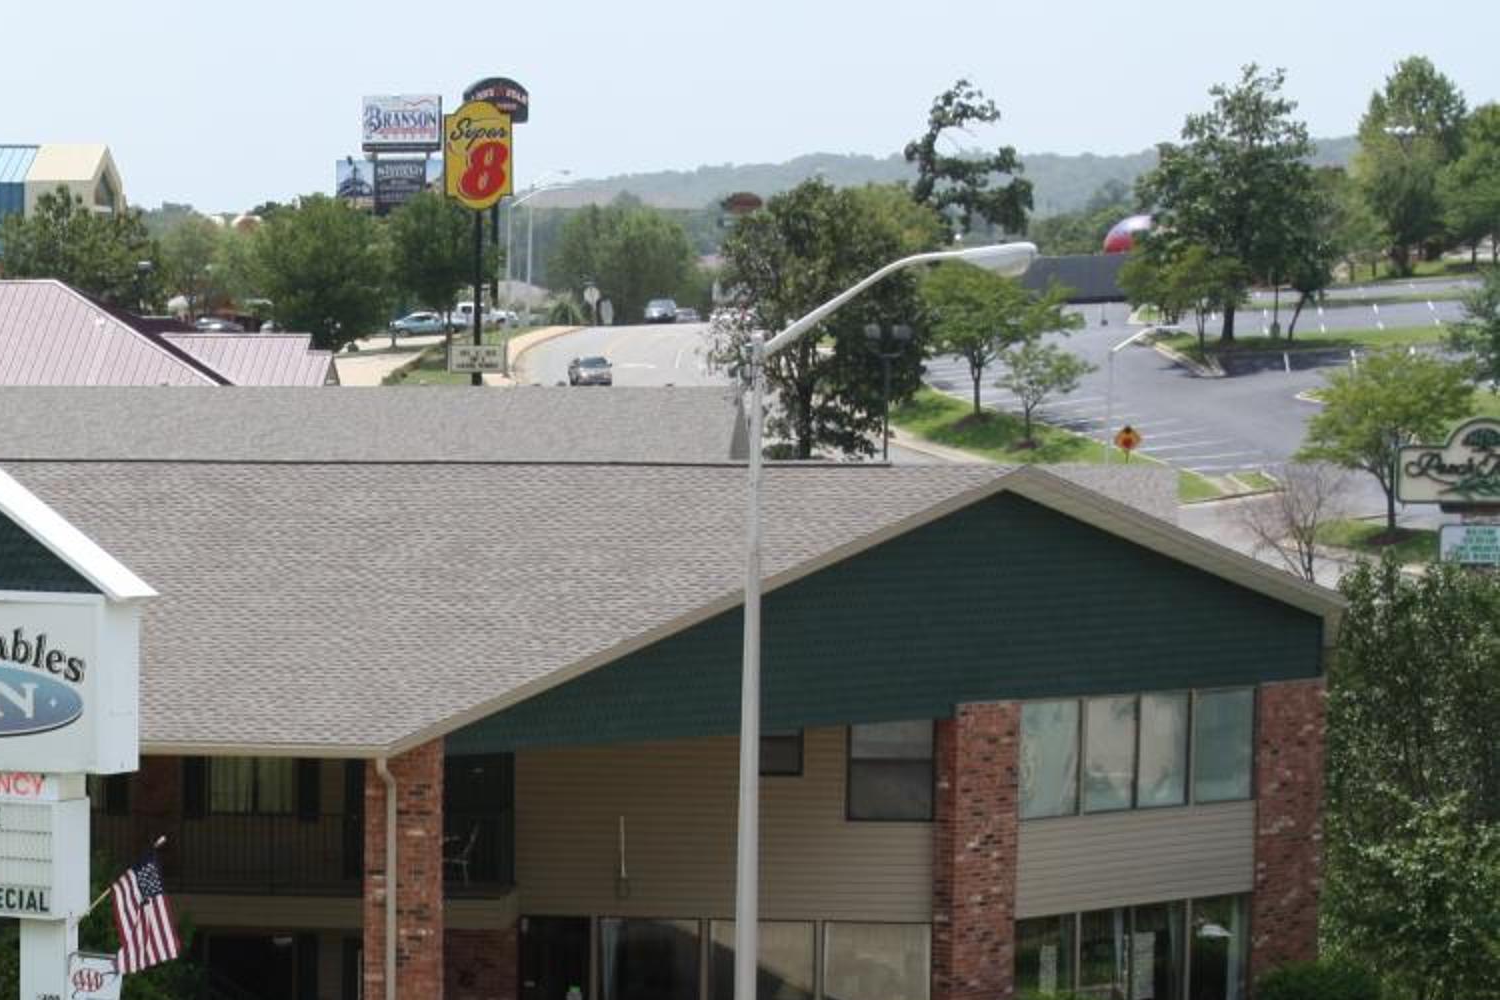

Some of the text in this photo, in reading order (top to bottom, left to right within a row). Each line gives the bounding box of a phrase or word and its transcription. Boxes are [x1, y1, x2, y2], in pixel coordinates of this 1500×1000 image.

[364, 104, 437, 132] BRANSON
[450, 117, 507, 151] Super
[459, 141, 509, 200] 8
